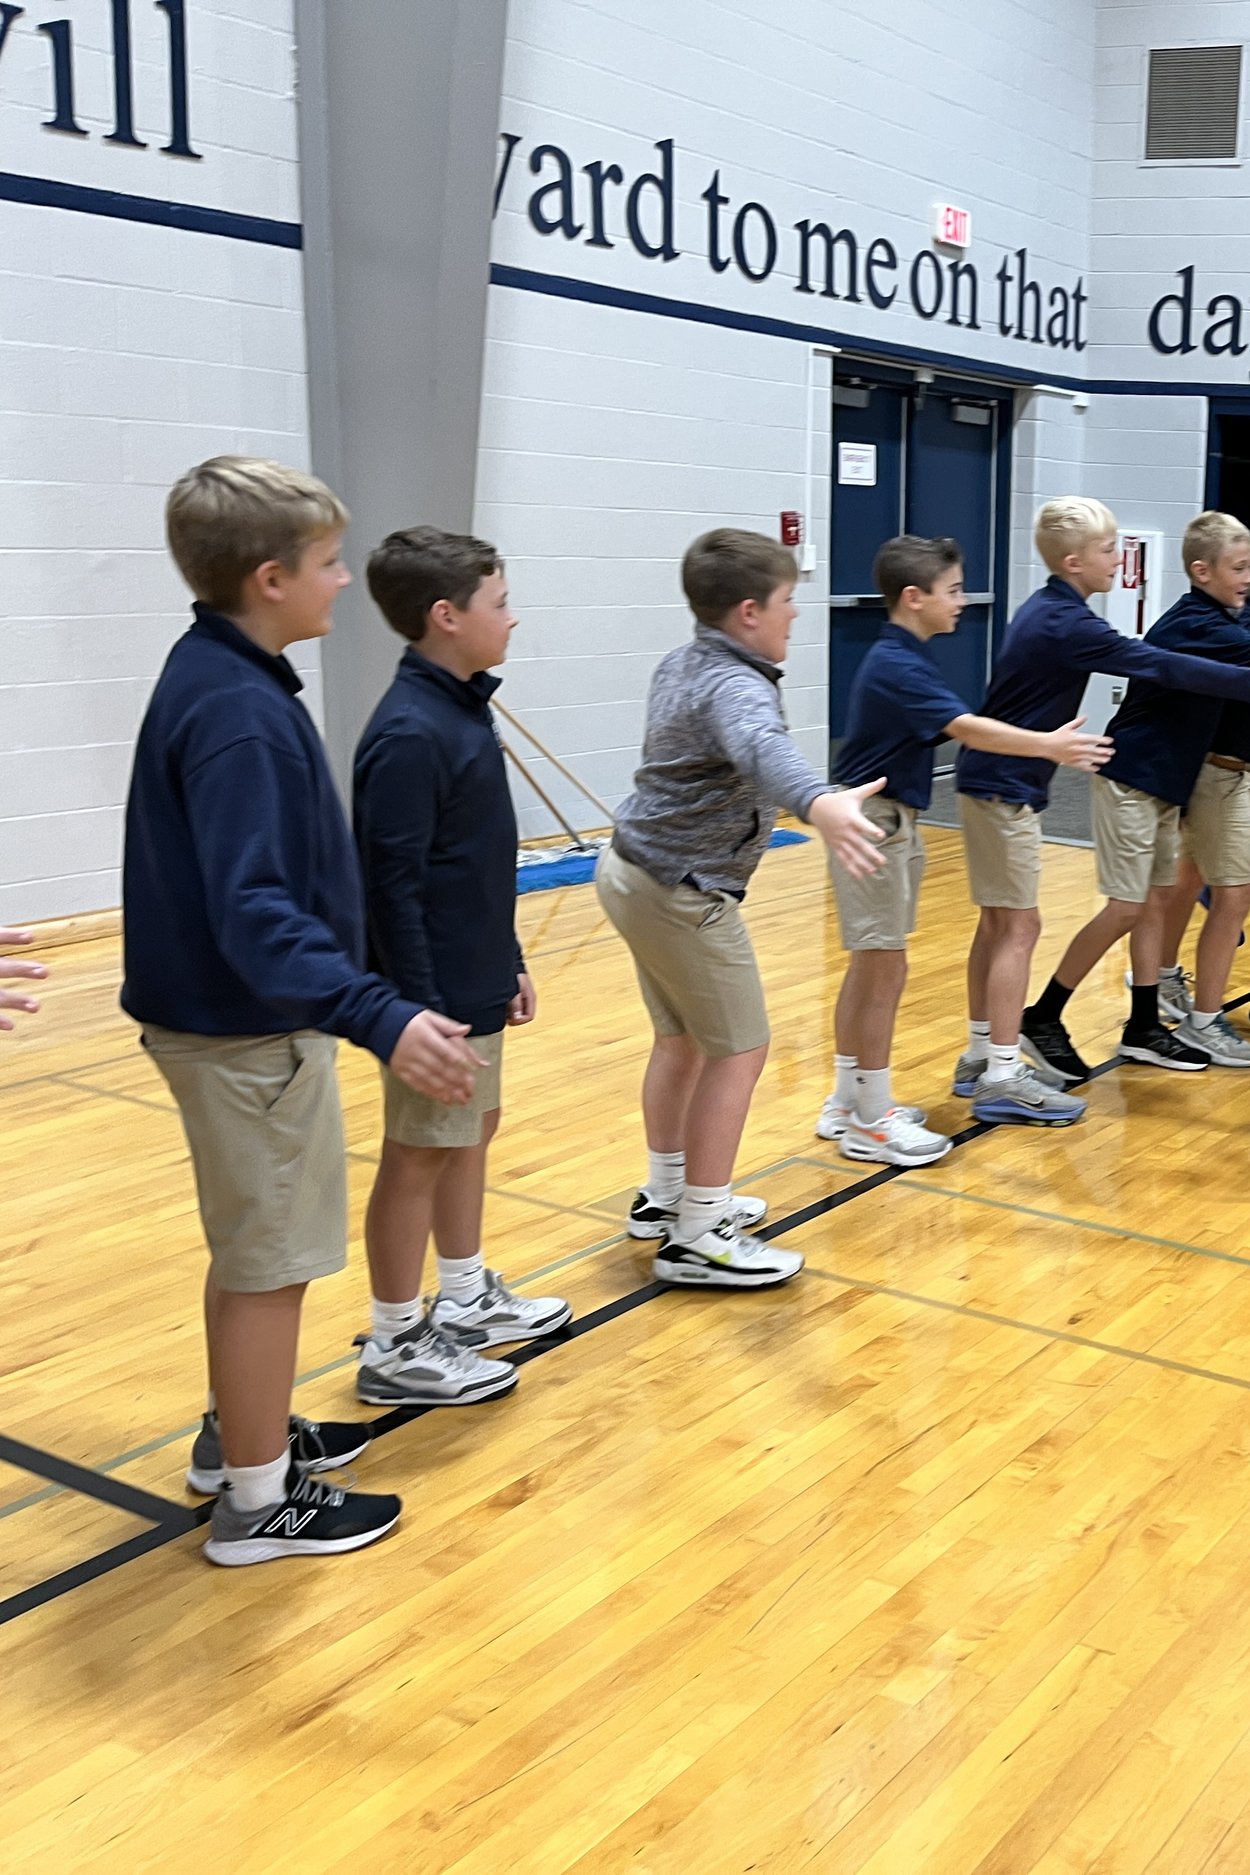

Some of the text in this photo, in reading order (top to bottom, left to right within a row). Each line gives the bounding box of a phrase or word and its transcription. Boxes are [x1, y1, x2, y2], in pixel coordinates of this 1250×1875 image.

[702, 169, 778, 282] to
[794, 218, 898, 310] me
[910, 249, 981, 331] on
[996, 247, 1089, 352] that
[945, 207, 967, 243] EXIT
